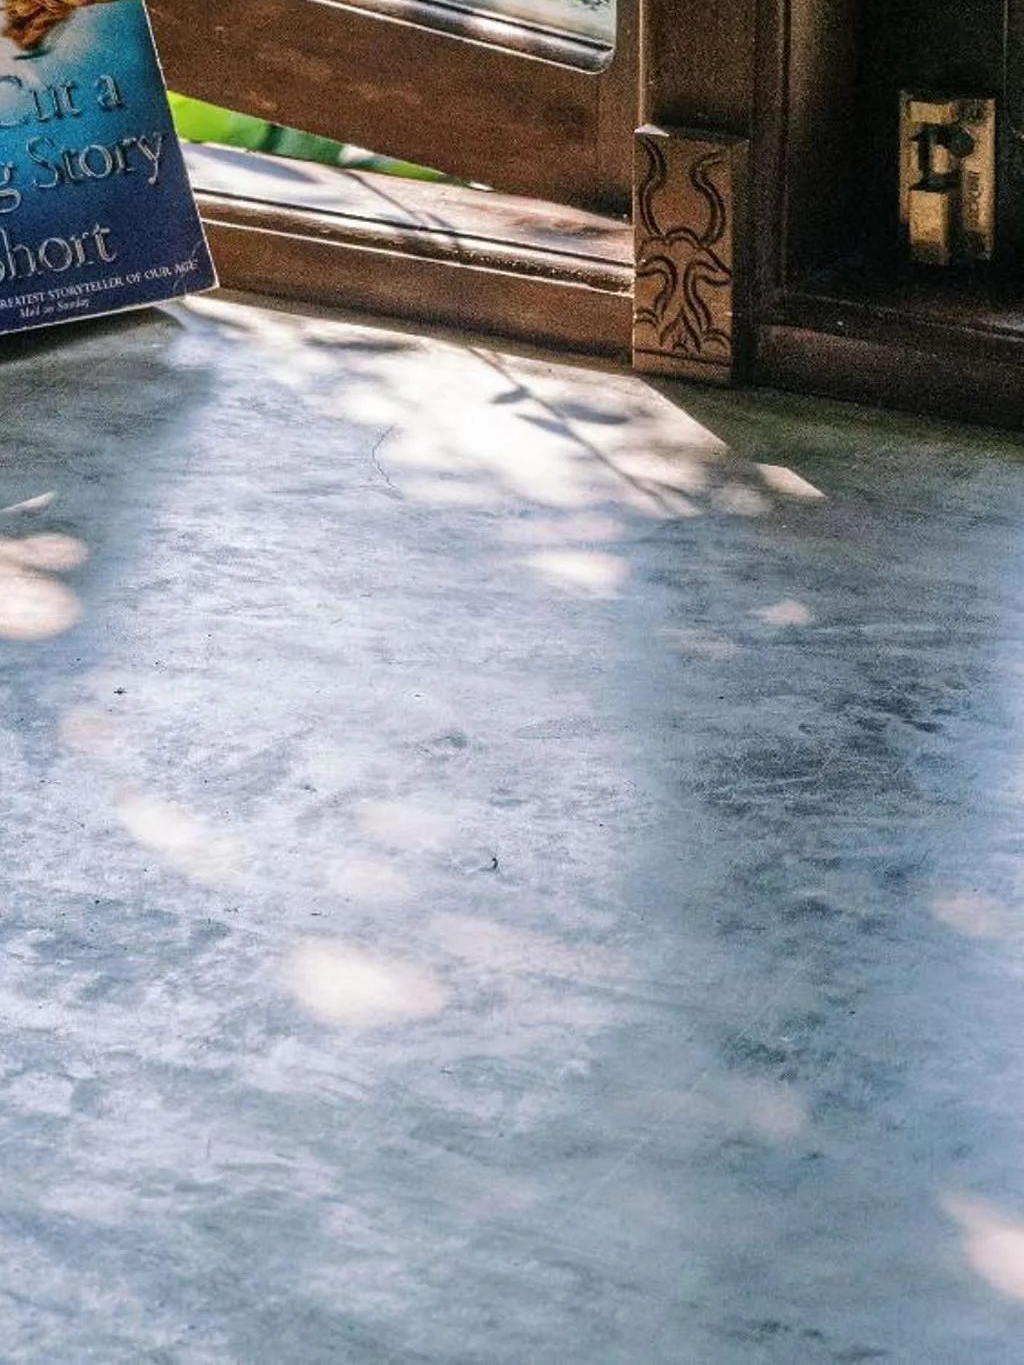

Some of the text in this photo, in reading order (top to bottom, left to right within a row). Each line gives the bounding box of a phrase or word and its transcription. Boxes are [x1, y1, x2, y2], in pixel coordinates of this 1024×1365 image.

[94, 72, 124, 113] a
[26, 133, 167, 192] Story
[47, 275, 125, 300] STORYTELLER
[126, 270, 142, 284] OF
[144, 266, 172, 280] OUR
[19, 298, 90, 319] Mail on Sunday
